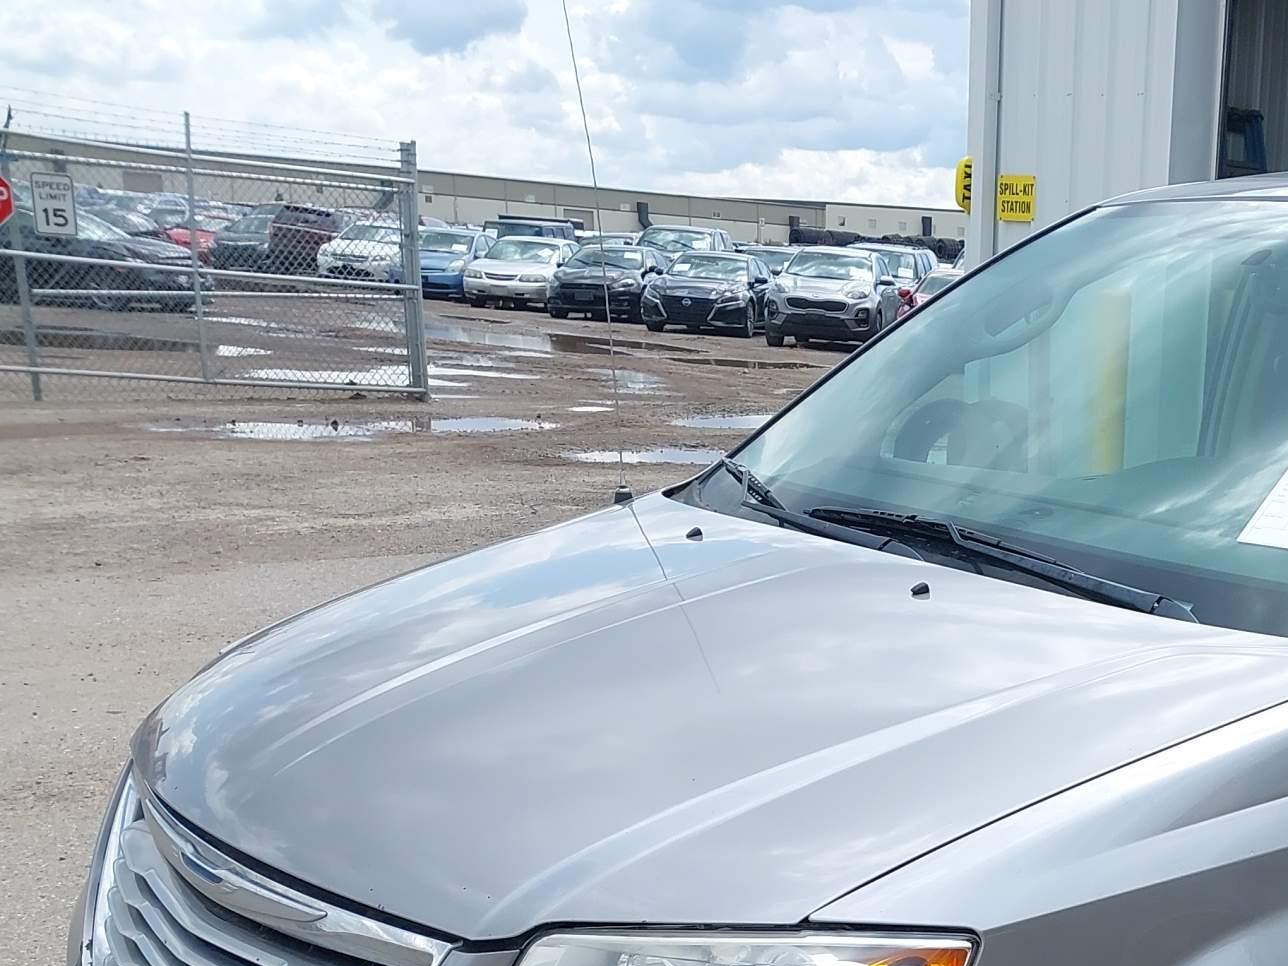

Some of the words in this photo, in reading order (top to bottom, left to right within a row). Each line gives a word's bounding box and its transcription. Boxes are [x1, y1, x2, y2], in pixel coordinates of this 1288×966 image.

[34, 181, 70, 191] SPEED
[999, 182, 1034, 196] SPILL-KIT
[39, 192, 67, 201] LIMIT
[1001, 200, 1031, 214] STATION
[42, 208, 69, 227] 15
